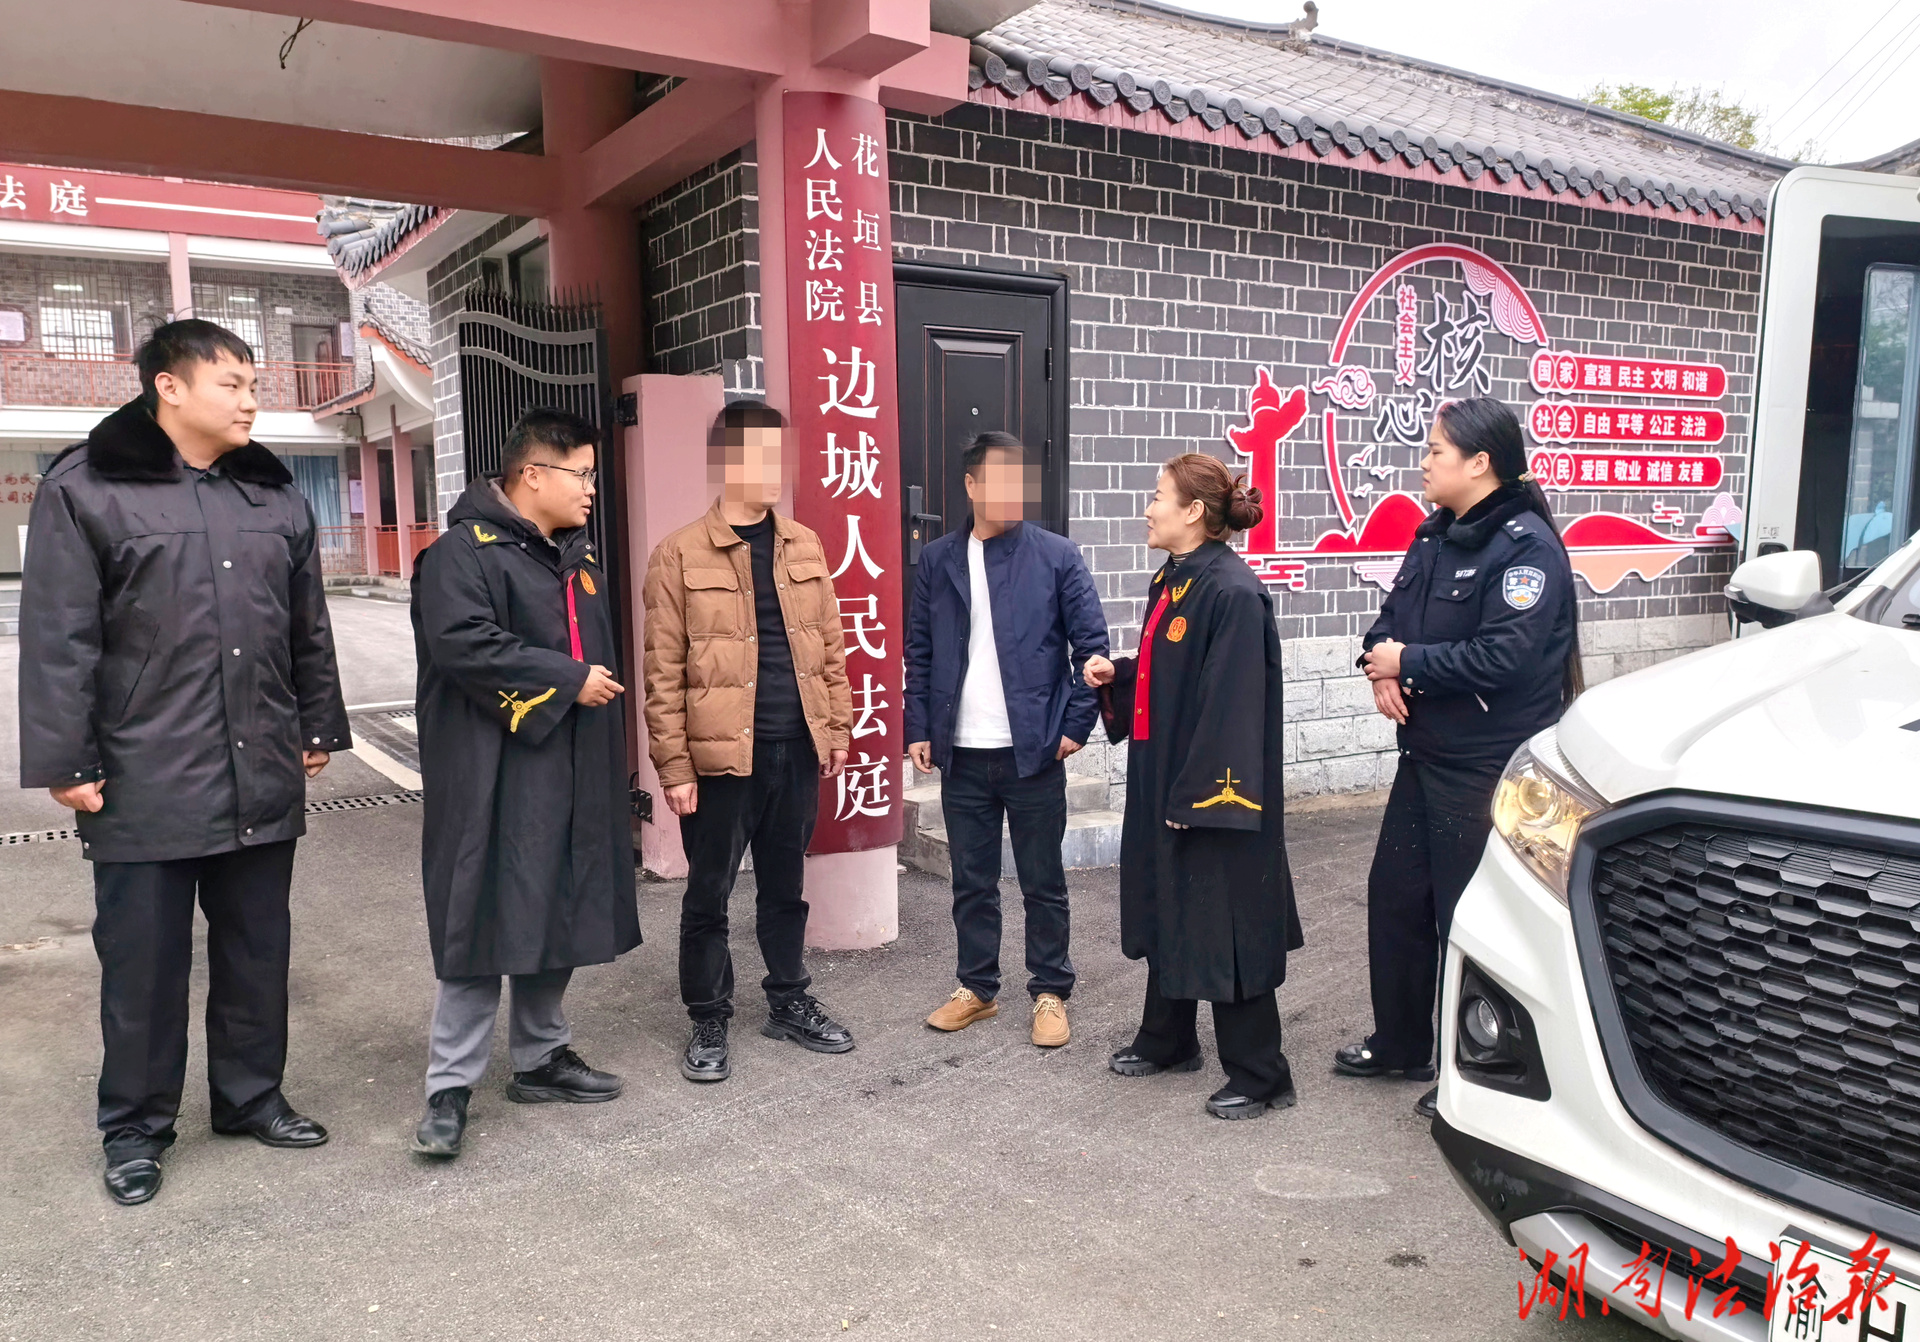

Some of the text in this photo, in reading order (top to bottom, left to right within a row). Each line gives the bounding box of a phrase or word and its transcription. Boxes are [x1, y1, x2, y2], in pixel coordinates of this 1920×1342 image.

[0, 174, 89, 217] 法庭
[803, 127, 846, 323] 人民法院
[850, 132, 884, 327] 花垣县
[1397, 289, 1418, 383] 社会主义
[1537, 359, 1709, 393] 国家 富强 民主 文明 和谐
[1535, 409, 1707, 438] 社会 自由 平等 公正 法治
[1534, 457, 1705, 483] 公民 爱国 敬业 诚信 友善
[817, 345, 892, 822] 边城人民法庭
